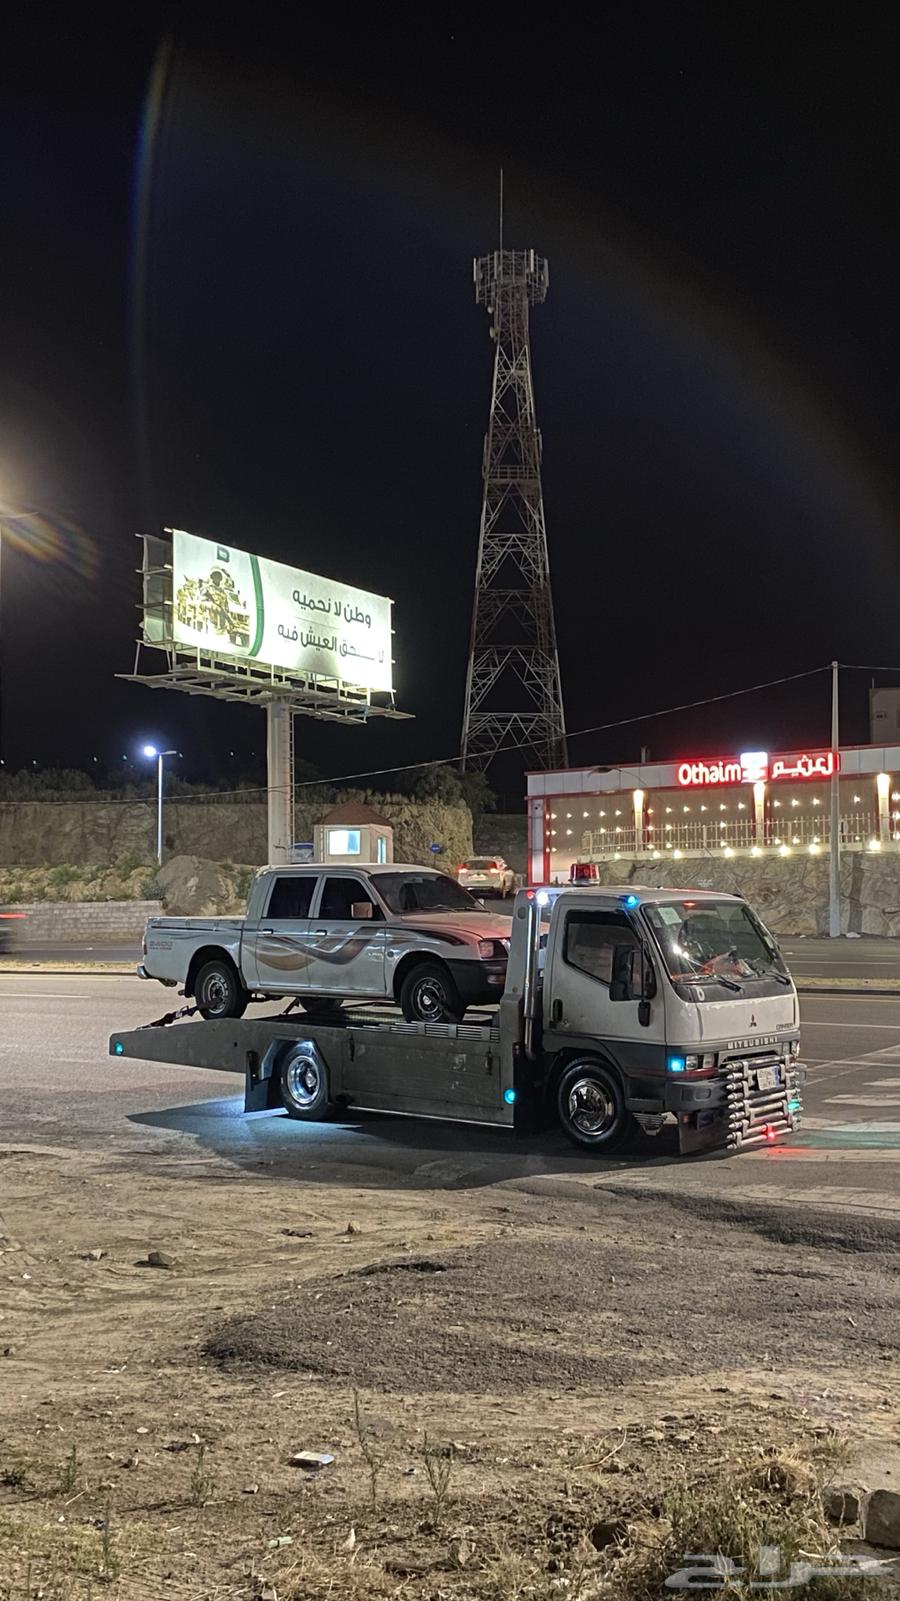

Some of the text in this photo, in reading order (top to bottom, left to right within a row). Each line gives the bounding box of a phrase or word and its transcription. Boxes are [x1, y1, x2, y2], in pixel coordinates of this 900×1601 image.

[292, 590, 372, 629] وطن لا نحميه
[300, 626, 338, 652] العيش
[678, 760, 742, 786] Othaim
[727, 1035, 778, 1050] MITSUBISHI
